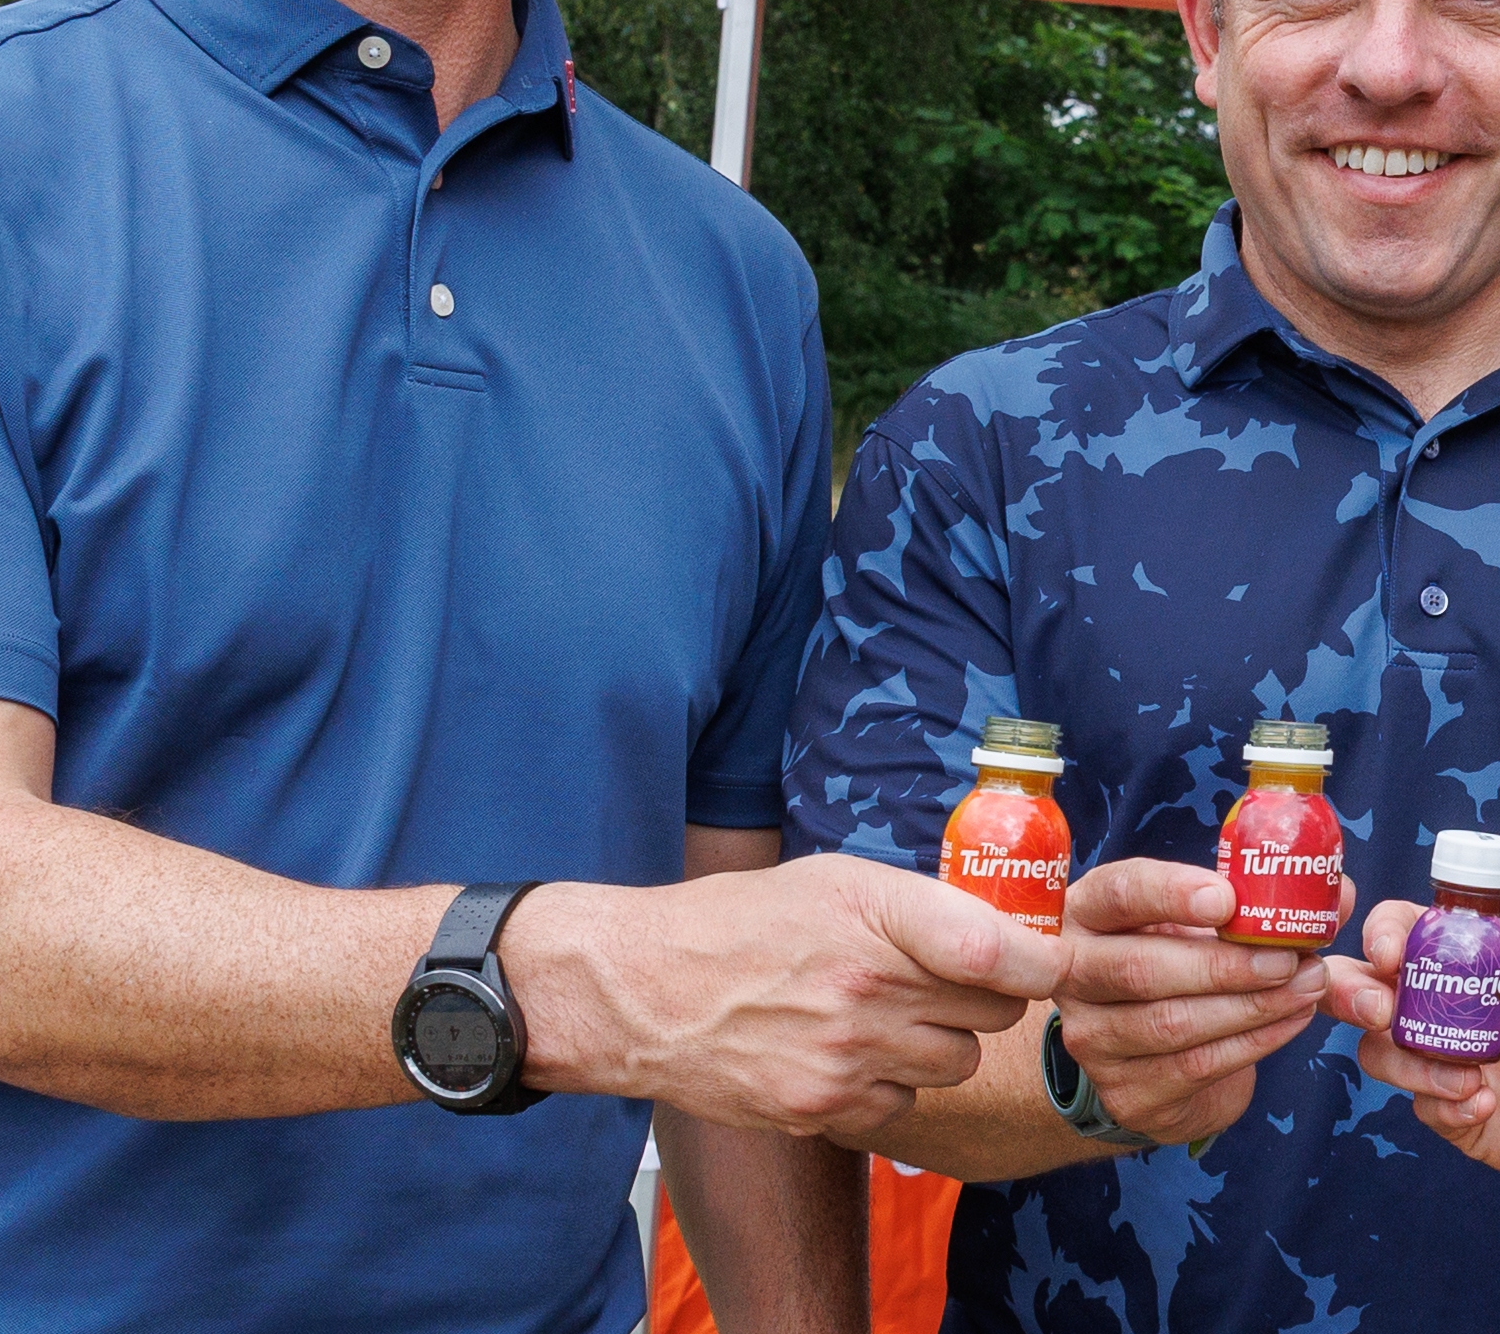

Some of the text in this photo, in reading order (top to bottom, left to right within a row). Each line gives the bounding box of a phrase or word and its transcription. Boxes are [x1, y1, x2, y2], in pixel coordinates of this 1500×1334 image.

[981, 842, 1009, 857] The
[1261, 840, 1290, 855] The
[960, 849, 1070, 880] Turmeric
[1240, 848, 1344, 876] Turmeric
[1045, 877, 1062, 891] Co.
[1326, 872, 1340, 886] Co.
[1005, 912, 1060, 927] RMERIC
[1240, 905, 1339, 922] RAW TURMERIC
[1260, 920, 1327, 934] & GINGER
[1419, 956, 1443, 973] The
[1480, 993, 1500, 1007] Co.
[1399, 1015, 1500, 1042] RAW TURMERIC
[1404, 1030, 1490, 1053] & BEETROOT
